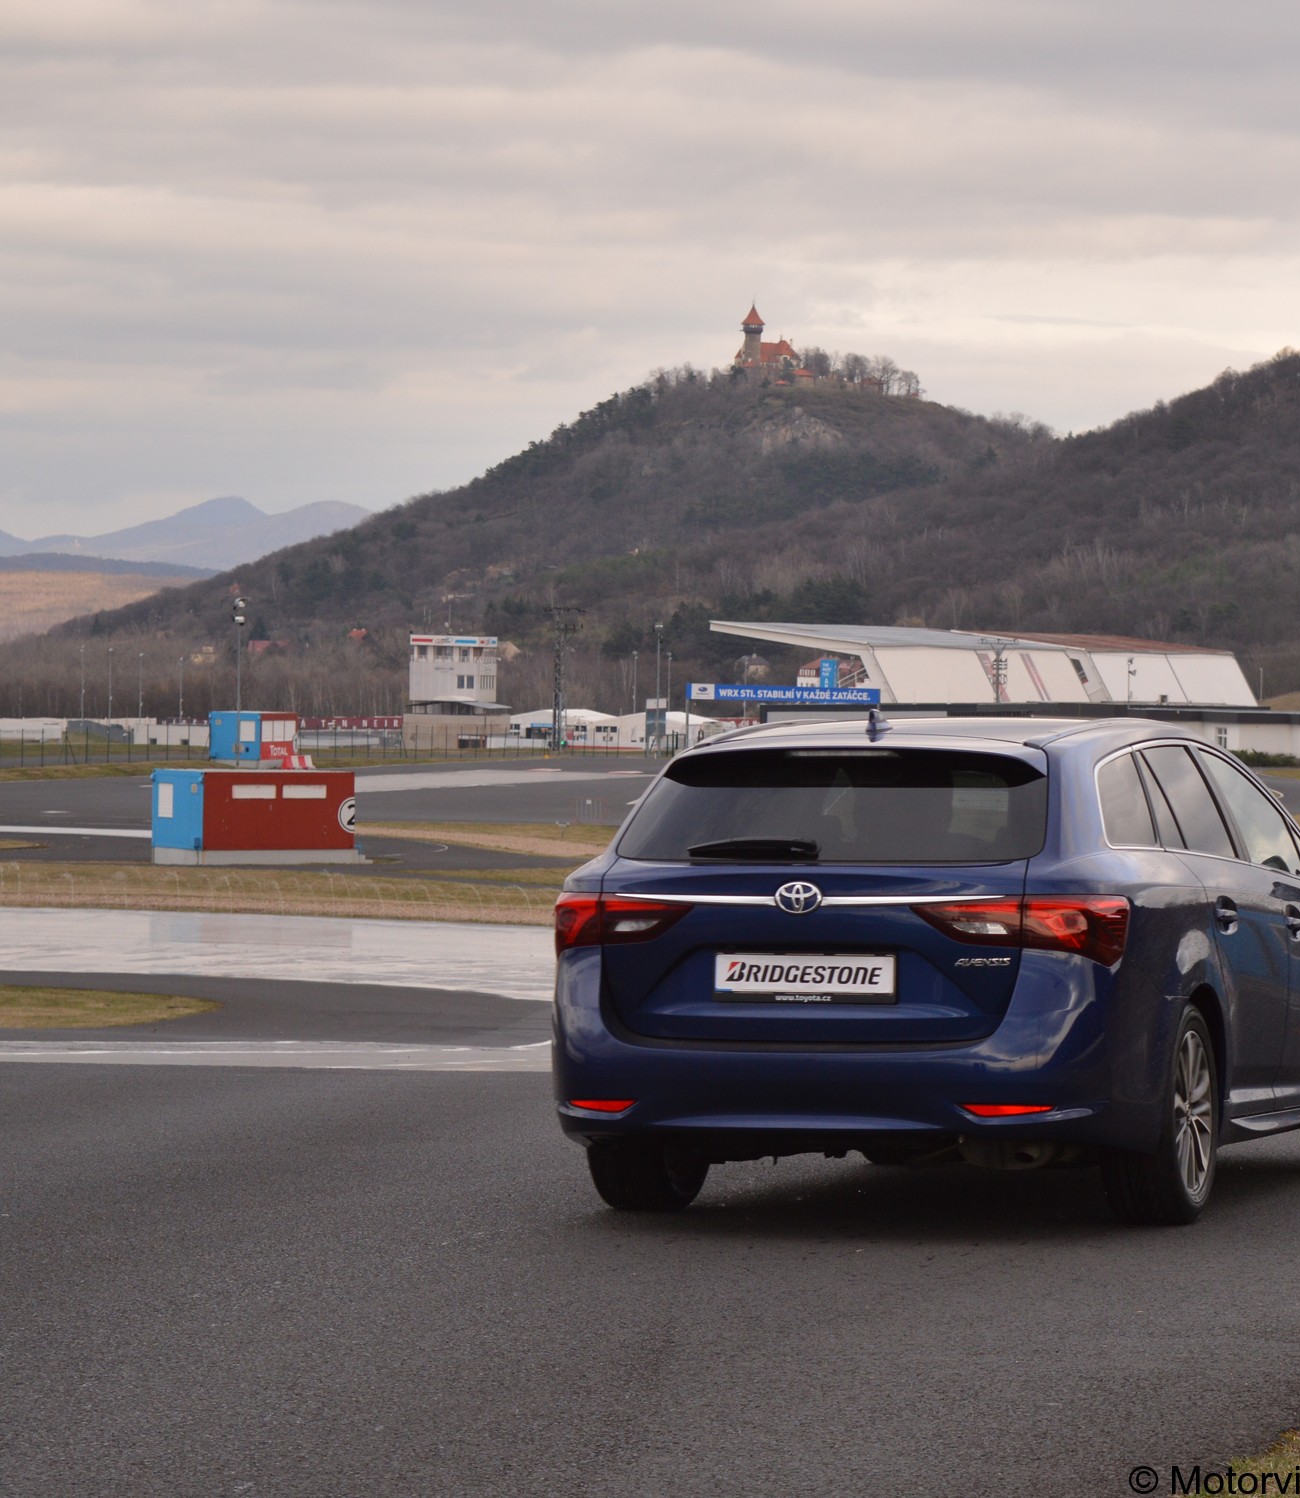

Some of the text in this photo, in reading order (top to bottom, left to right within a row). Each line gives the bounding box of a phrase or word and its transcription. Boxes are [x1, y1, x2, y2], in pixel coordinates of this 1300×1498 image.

[719, 688, 739, 698] WRX
[757, 687, 795, 699] STABILNÍ
[796, 690, 802, 699] V
[803, 688, 831, 700] KAŽDÉ
[269, 745, 289, 756] TOTAL
[954, 957, 1012, 968] AVENSIS
[725, 961, 883, 985] BRIDGESTONE
[775, 993, 832, 1003] www.toyota.cz
